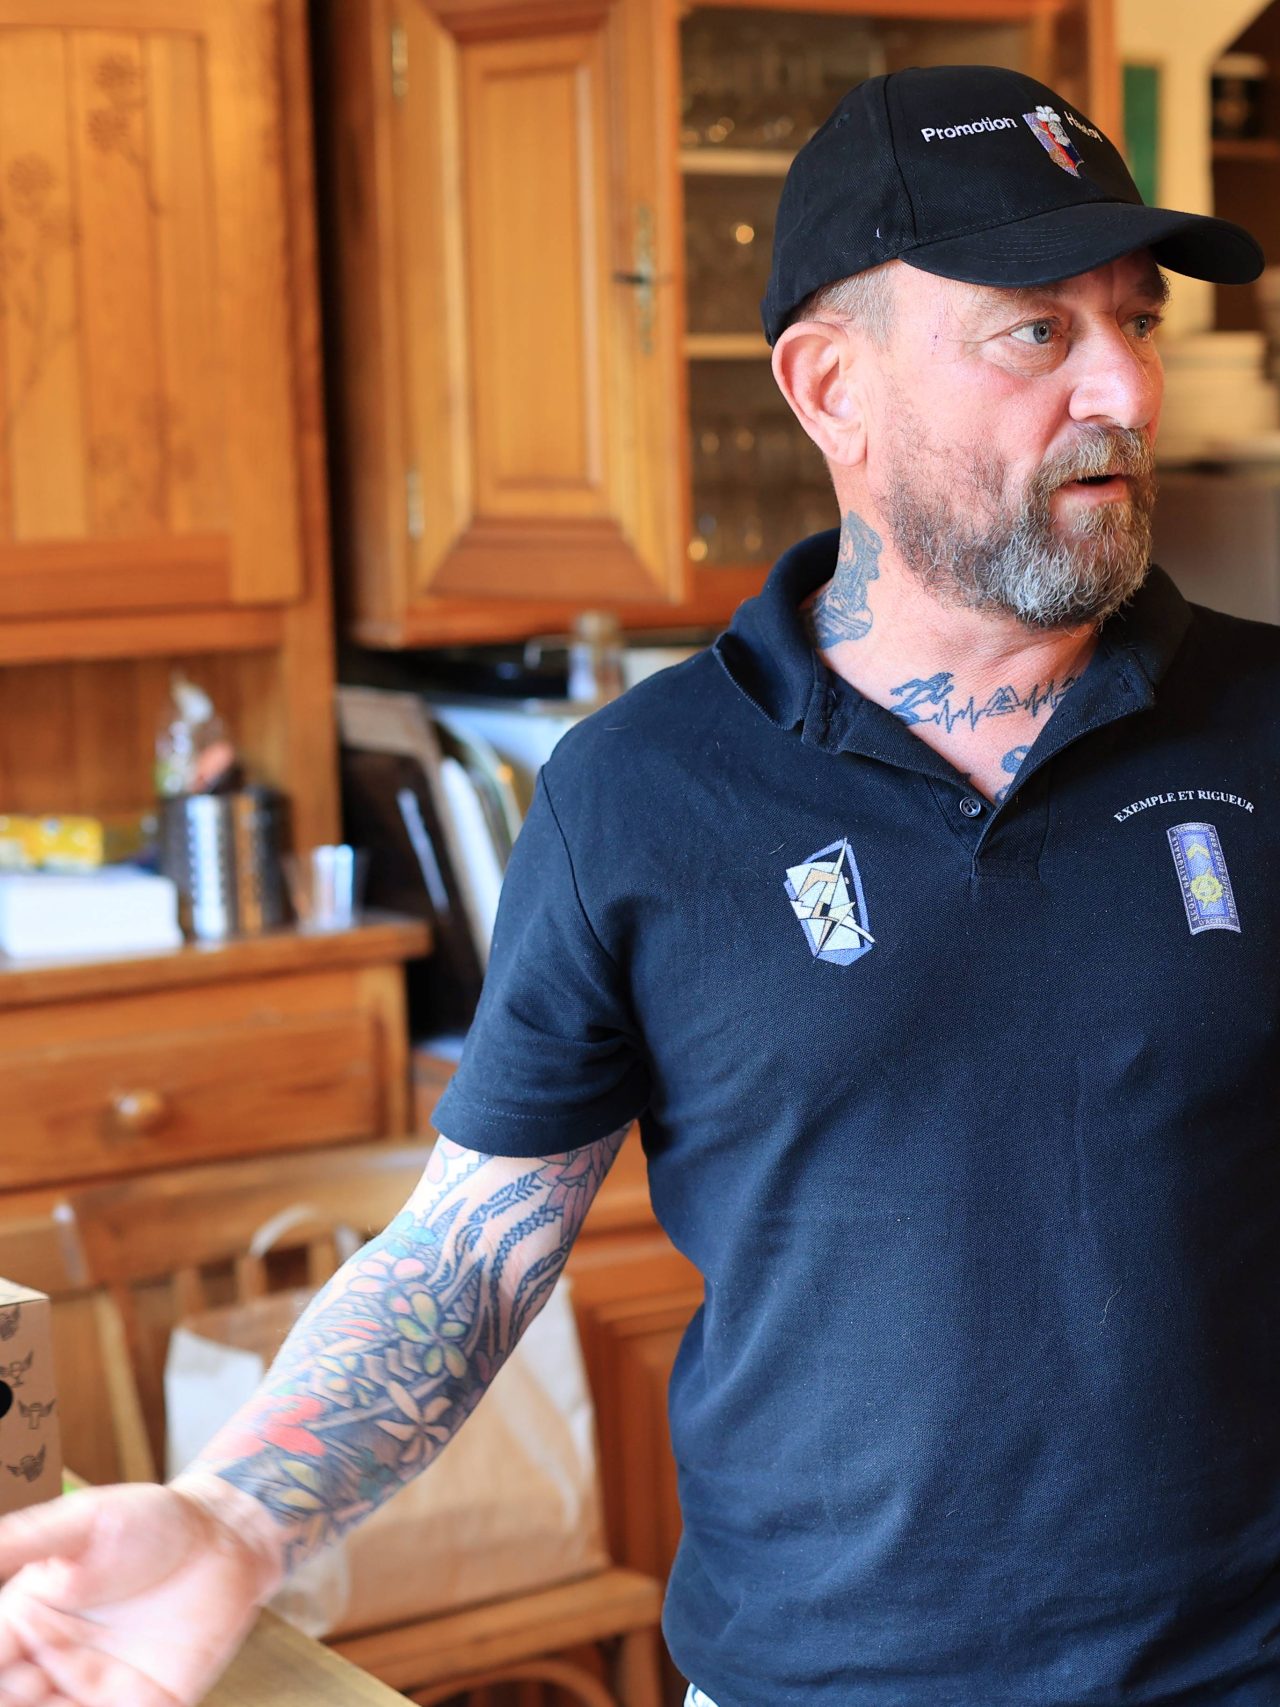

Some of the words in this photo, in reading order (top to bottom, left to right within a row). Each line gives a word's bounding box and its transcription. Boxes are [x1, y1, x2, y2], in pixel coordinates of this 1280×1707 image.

[920, 116, 1018, 143] Promotion
[1113, 791, 1177, 823] EXEMPLE
[1177, 789, 1195, 801] ET
[1197, 789, 1255, 814] RIGUEUR
